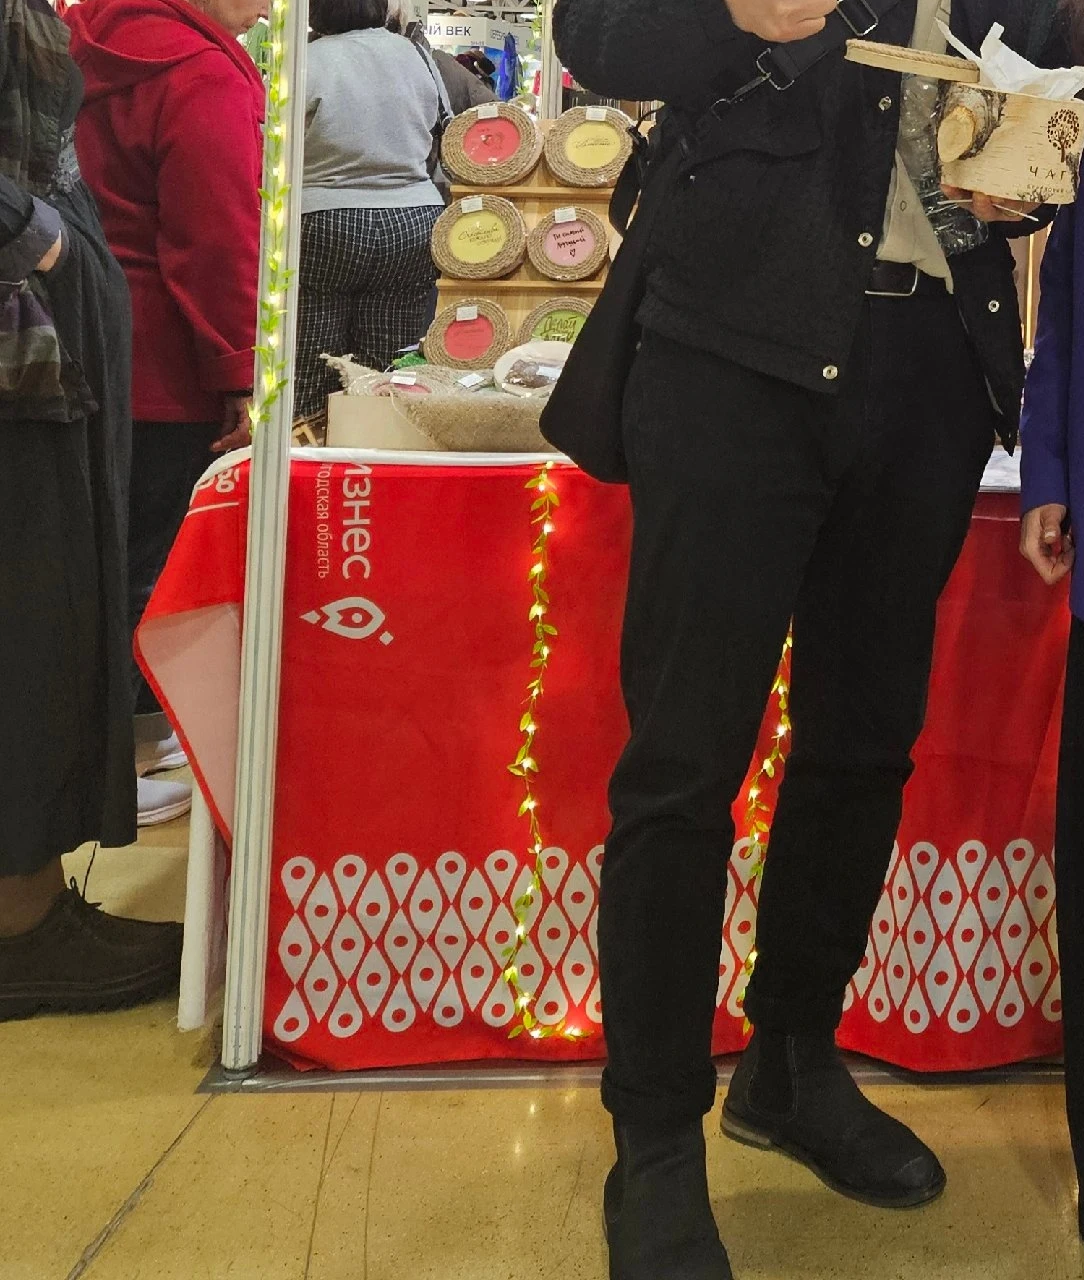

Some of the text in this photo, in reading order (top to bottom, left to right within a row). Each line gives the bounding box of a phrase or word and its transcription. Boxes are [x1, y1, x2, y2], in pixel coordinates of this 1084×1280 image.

[446, 25, 472, 37] ВЕК
[342, 462, 373, 580] изнес
[317, 523, 333, 579] область
